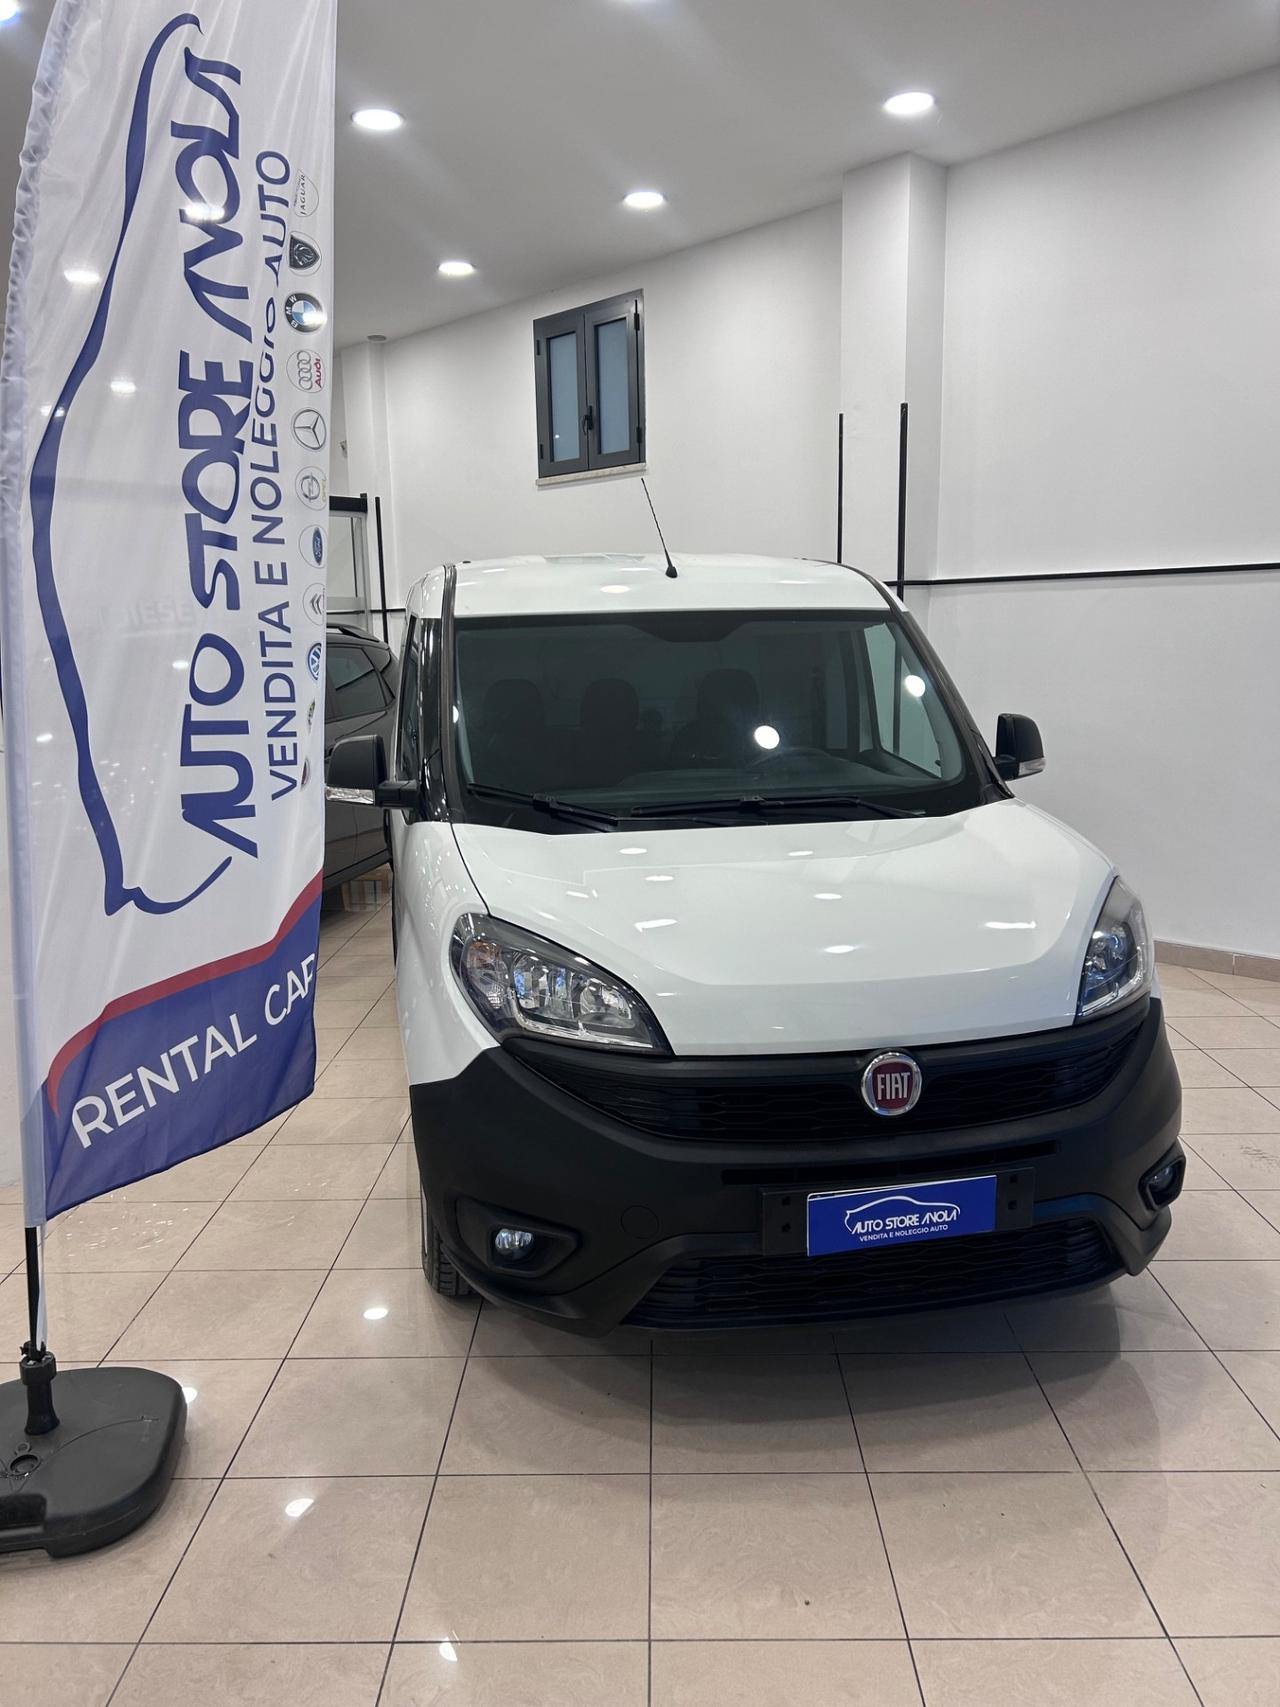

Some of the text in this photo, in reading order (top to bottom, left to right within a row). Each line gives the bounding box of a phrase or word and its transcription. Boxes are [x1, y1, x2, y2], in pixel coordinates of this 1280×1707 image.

[314, 357, 322, 389] Audi
[178, 350, 253, 611] STORE
[250, 151, 298, 800] VENDITA E NOLEGGIO AUTO
[180, 633, 258, 858] AUTO
[71, 1013, 257, 1149] RENTAL
[877, 1072, 911, 1100] FIAT
[852, 1219, 883, 1235] AUTO
[885, 1214, 920, 1230] STORE
[859, 1232, 888, 1242] VENDITA
[894, 1226, 929, 1237] NOLEGGIO
[929, 1224, 948, 1232] AUTO
